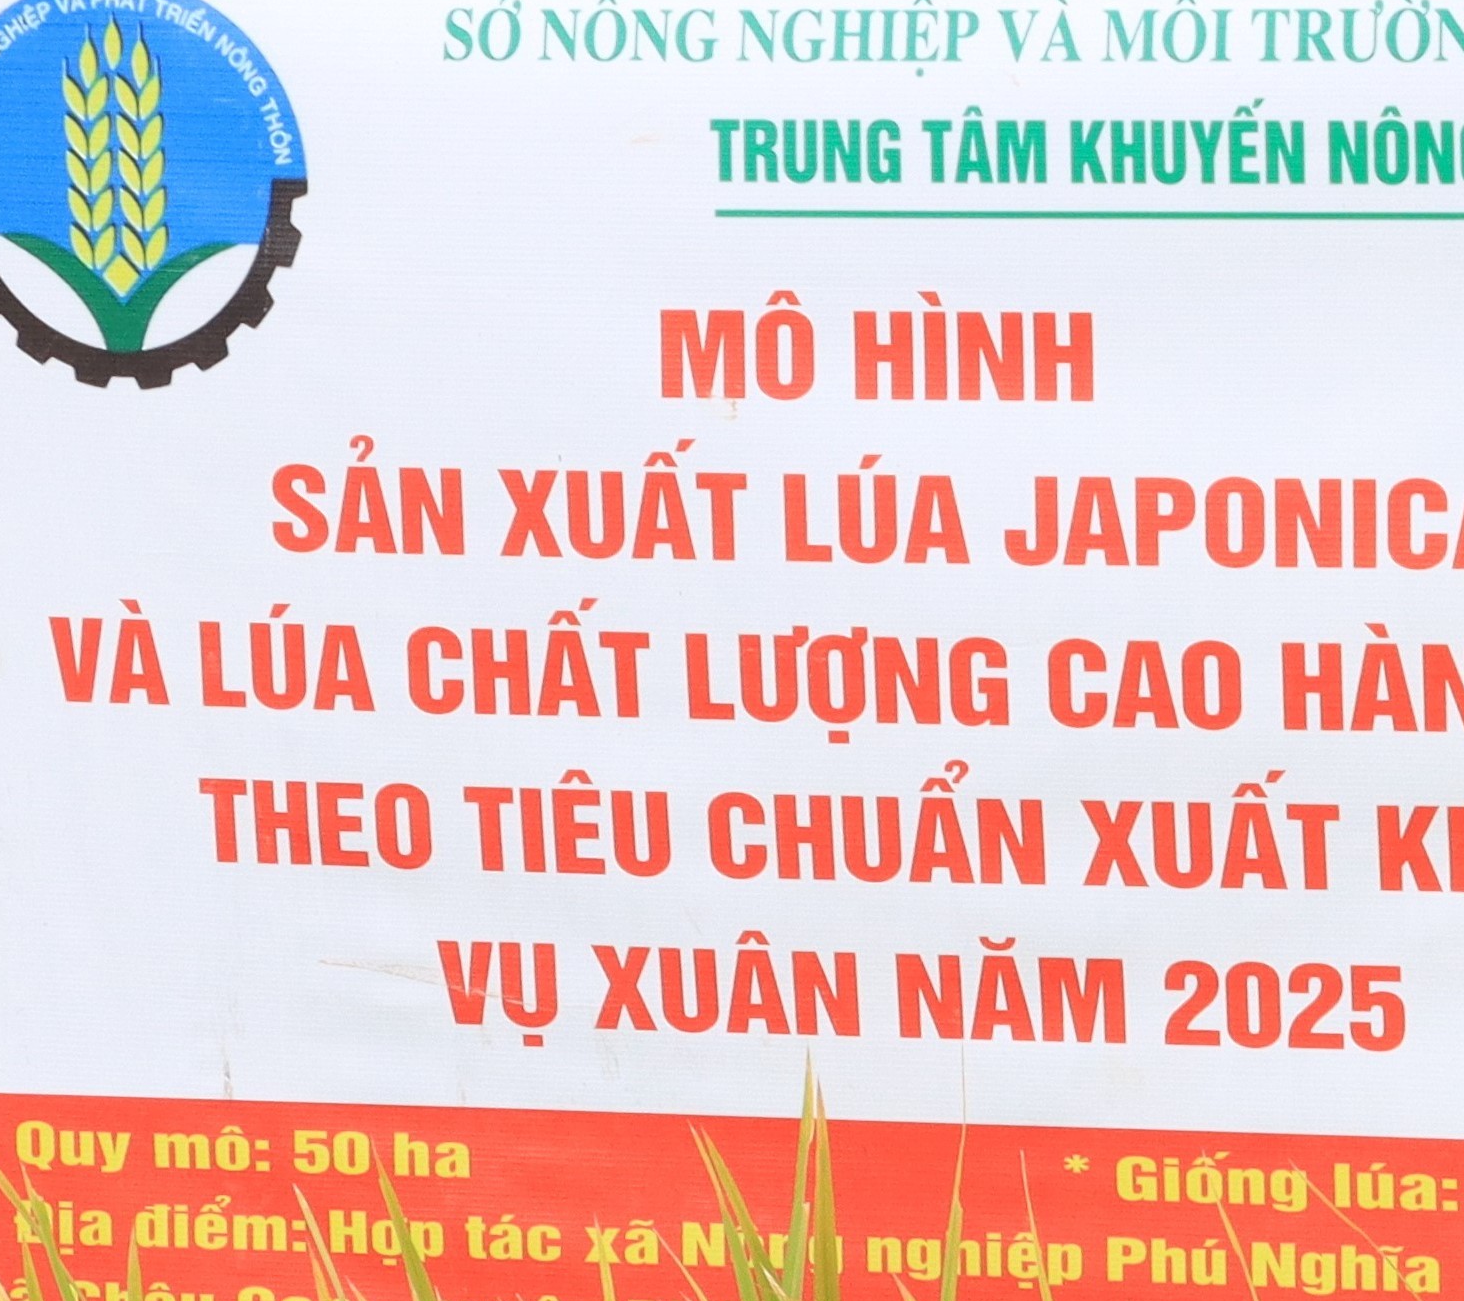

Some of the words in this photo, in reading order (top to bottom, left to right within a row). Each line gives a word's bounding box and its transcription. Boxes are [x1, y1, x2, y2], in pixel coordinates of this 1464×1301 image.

[214, 34, 267, 97] NÔNG
[258, 96, 293, 165] THÔN
[706, 115, 906, 187] TRUNG
[919, 101, 1052, 187] TÂM
[1066, 96, 1310, 188] KHUYẾN
[660, 289, 816, 401] MÔ
[853, 290, 1095, 403] HÌNH
[271, 434, 466, 557] SẢN
[499, 438, 748, 562] XUẤT
[782, 453, 971, 565] LÚA
[49, 598, 170, 706] VÀ
[199, 602, 376, 713] LÚA
[406, 597, 651, 719] CHẤT
[684, 624, 1011, 745] LƯỢNG
[1047, 637, 1243, 732] CAO
[198, 777, 433, 871] THEO
[463, 768, 672, 879] TIÊU
[707, 758, 1047, 886] CHUẨN
[1081, 769, 1341, 891] XUẤT
[437, 939, 559, 1048] VỤ
[592, 929, 861, 1038] XUÂN
[895, 935, 1127, 1045] NĂM
[1163, 959, 1407, 1053] 2025
[15, 1119, 131, 1174] Quy
[153, 1125, 271, 1172] mô:
[293, 1129, 371, 1175] 50
[394, 1130, 471, 1179] ha
[1115, 1151, 1309, 1213] Giống
[1334, 1162, 1459, 1212] lúa:
[135, 1195, 309, 1253] điểm:
[329, 1209, 445, 1266] Hợp
[464, 1214, 562, 1262] tác
[584, 1219, 660, 1266] xã
[1106, 1236, 1228, 1286] Phú
[1250, 1241, 1441, 1296] Nghĩa
